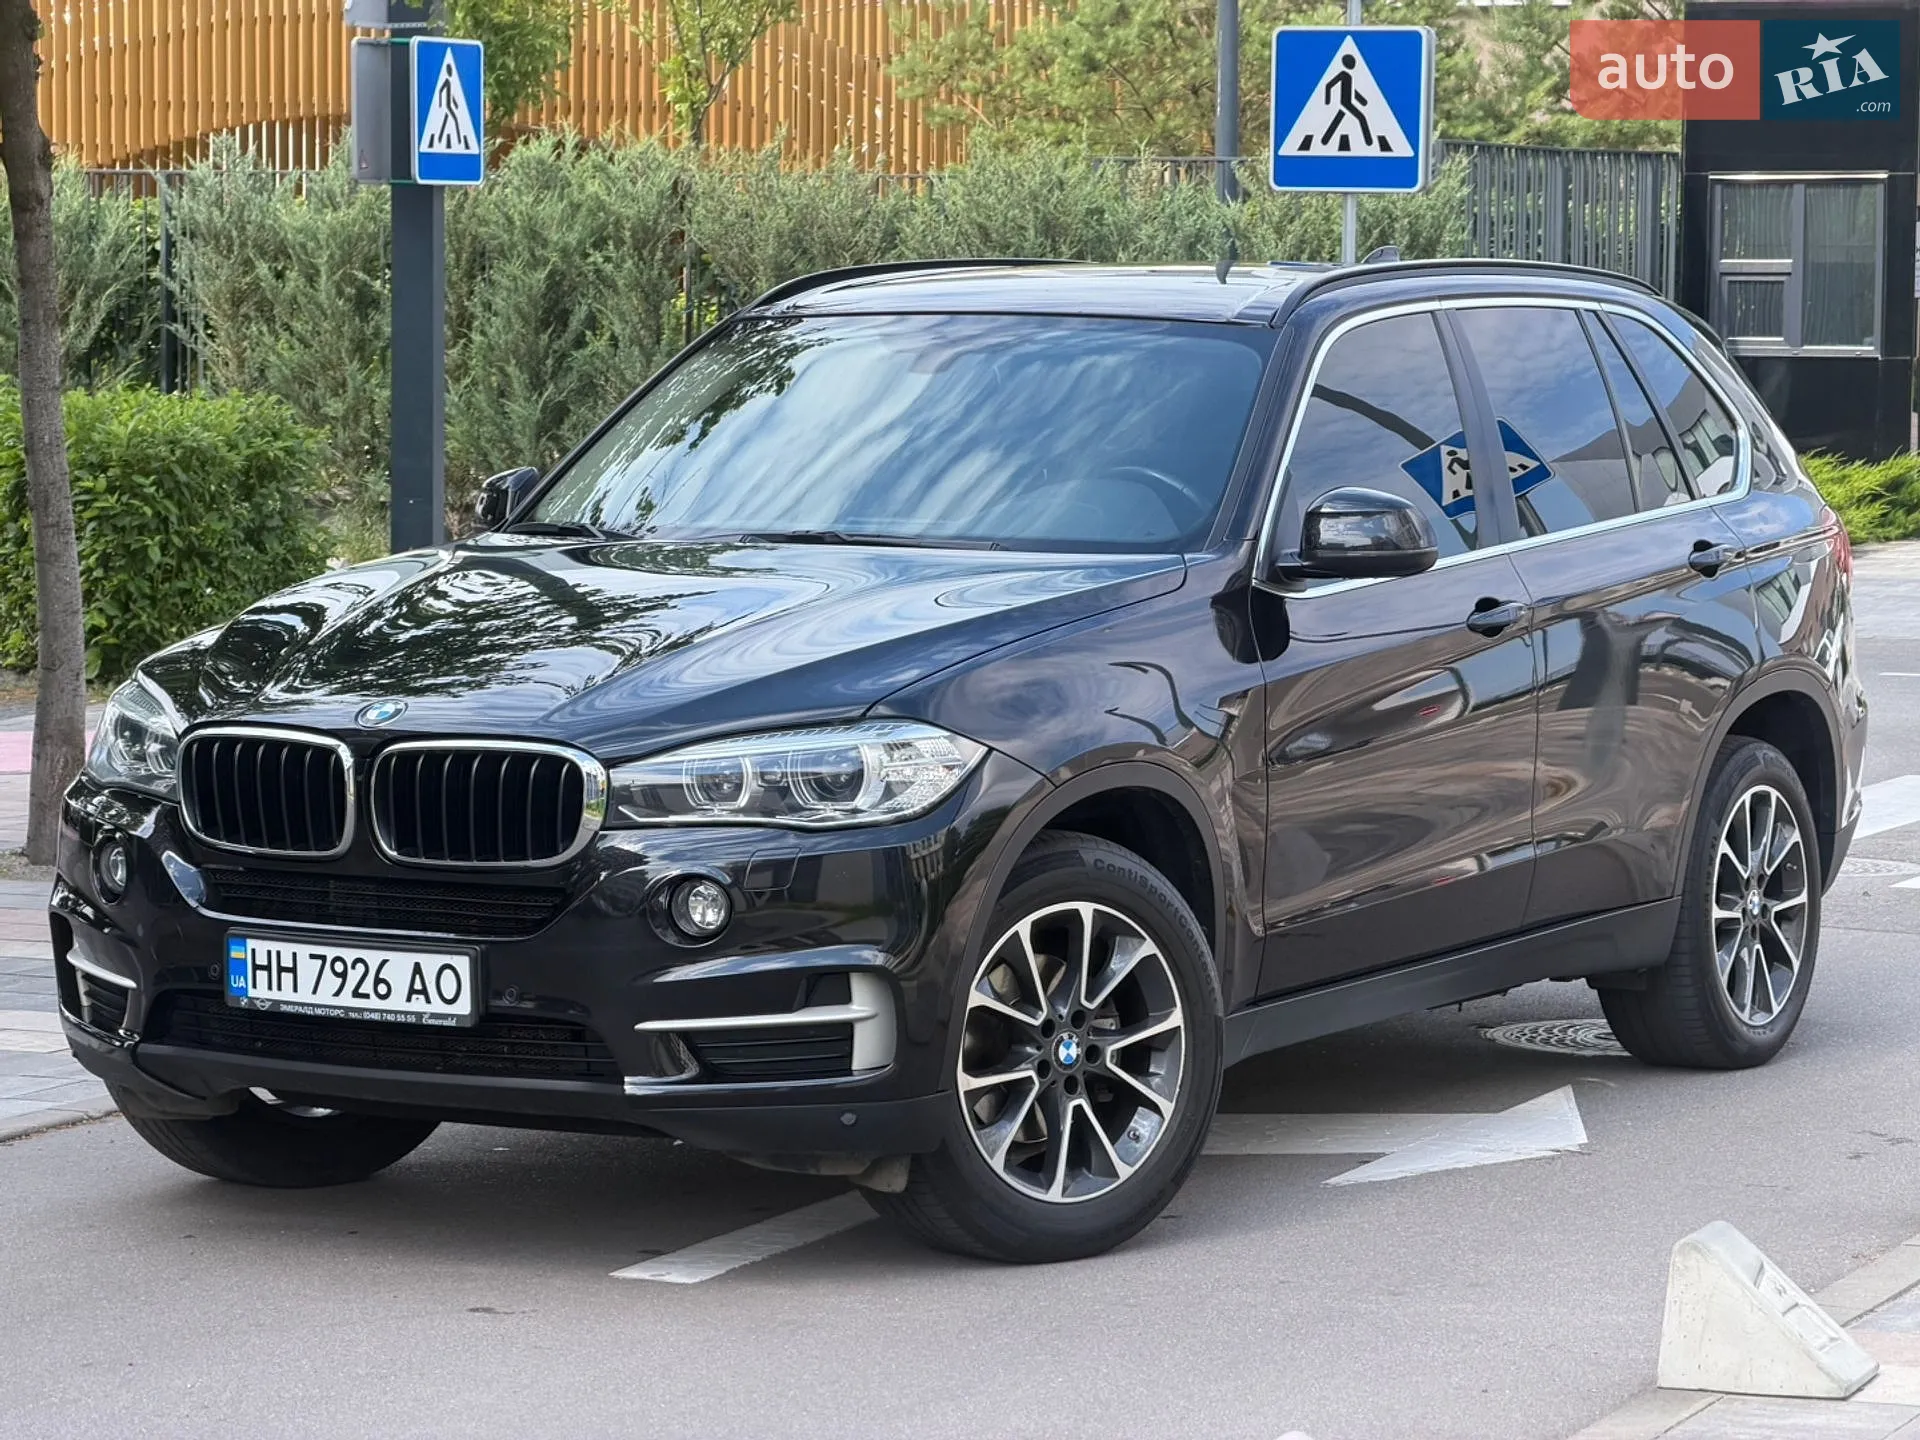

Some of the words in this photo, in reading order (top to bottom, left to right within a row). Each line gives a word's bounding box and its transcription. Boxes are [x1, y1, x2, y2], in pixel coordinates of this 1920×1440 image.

[231, 975, 247, 988] UA
[251, 947, 299, 993] HH
[309, 953, 392, 1000] 7926
[405, 961, 462, 1005] AO
[314, 1007, 345, 1017] МОТОРС
